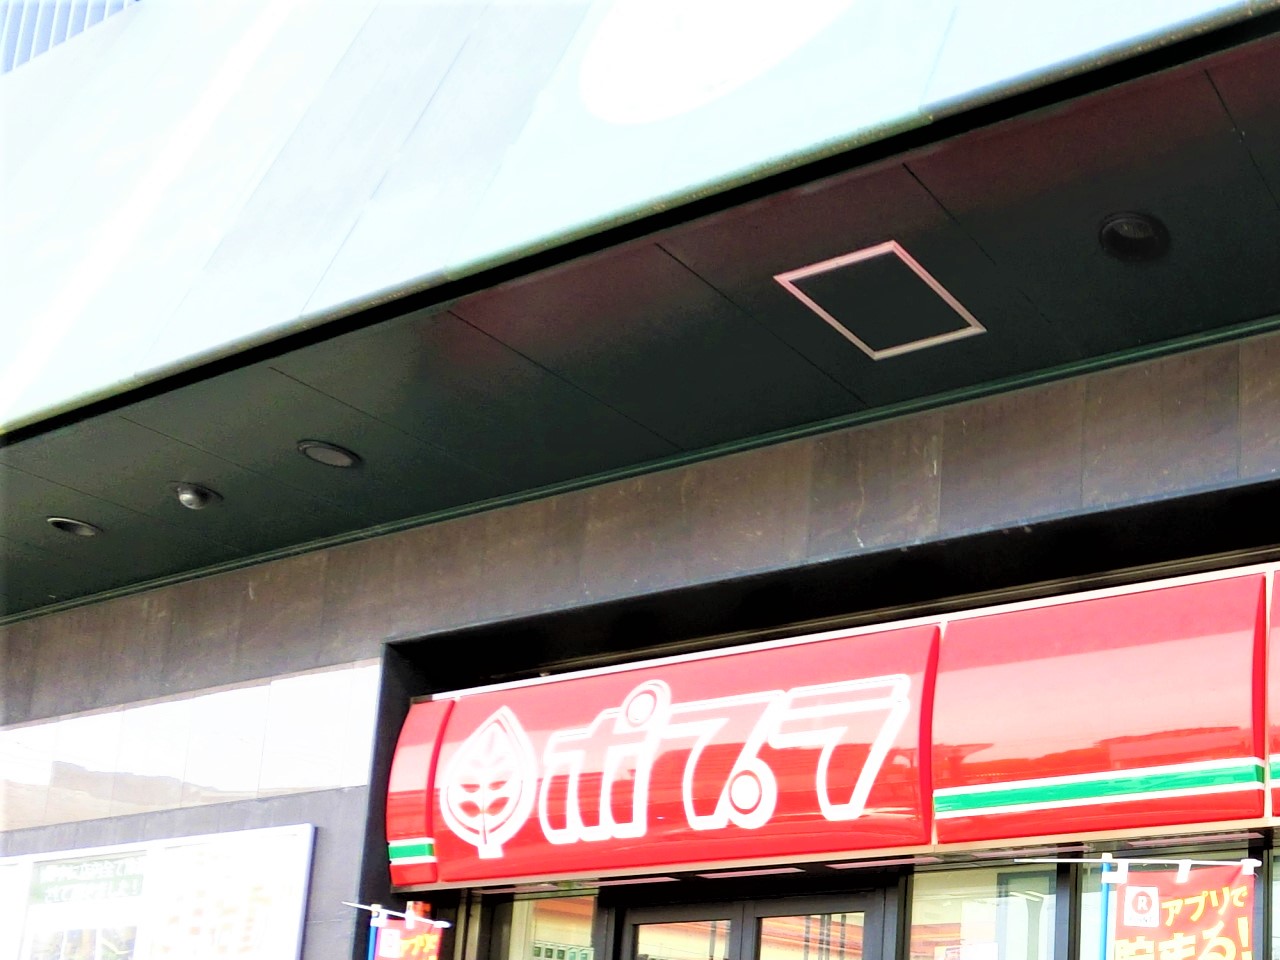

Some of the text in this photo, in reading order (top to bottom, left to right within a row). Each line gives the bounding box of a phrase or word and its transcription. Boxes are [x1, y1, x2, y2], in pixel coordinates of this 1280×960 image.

[539, 674, 910, 844] ポプラ
[1161, 885, 1249, 927] アプリで
